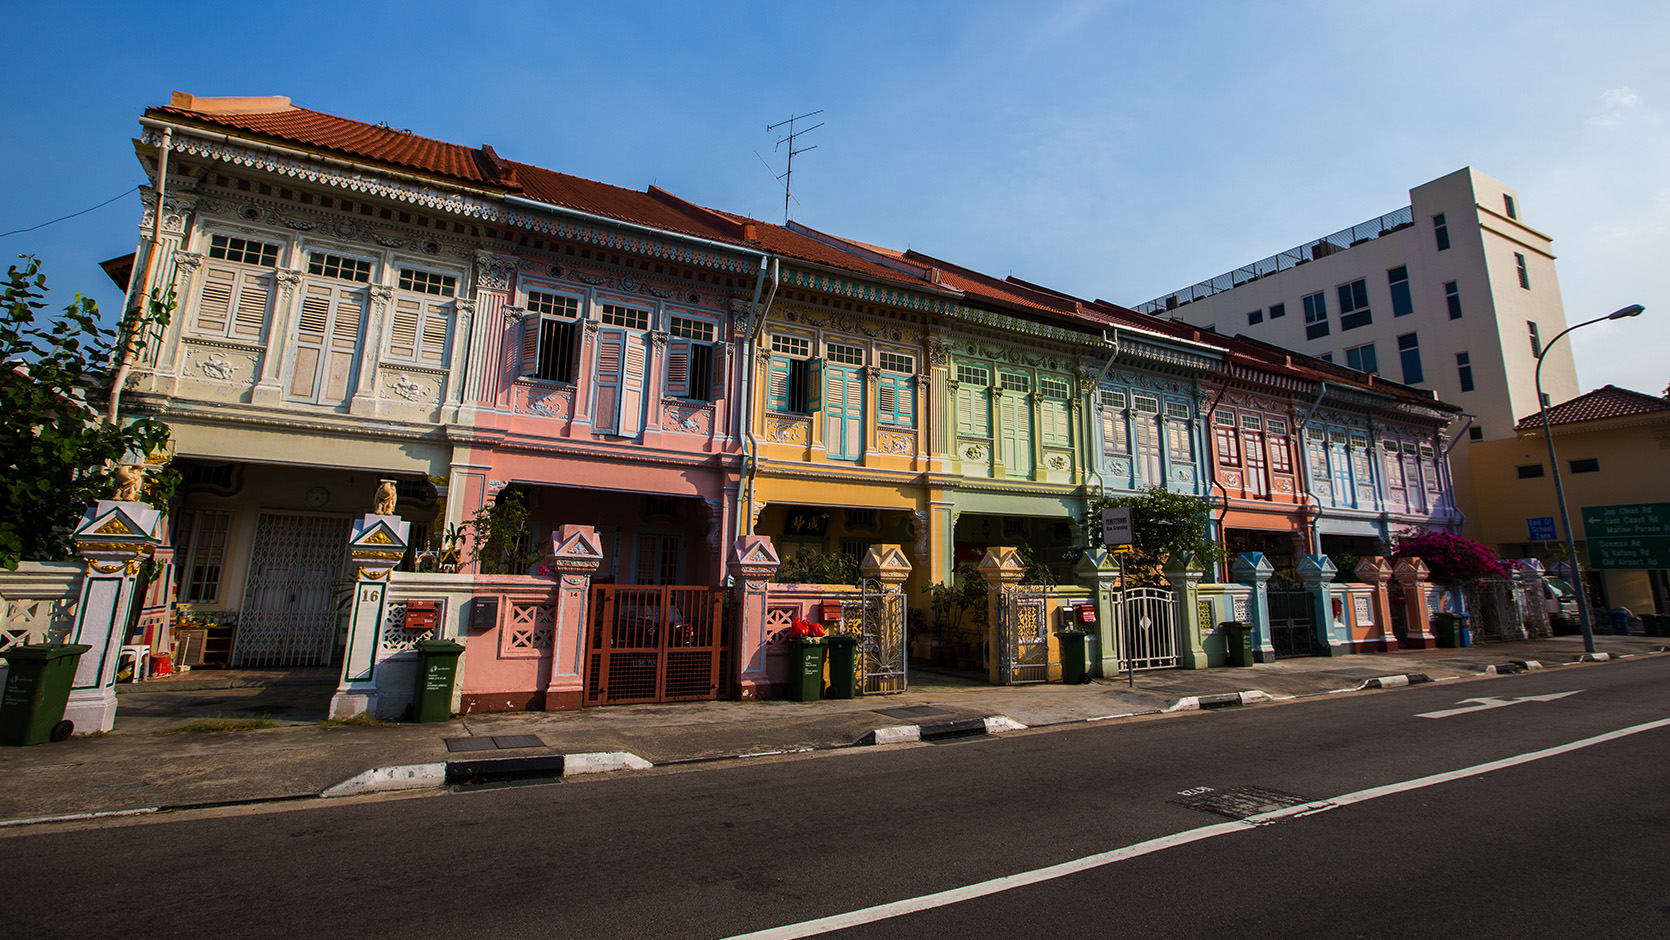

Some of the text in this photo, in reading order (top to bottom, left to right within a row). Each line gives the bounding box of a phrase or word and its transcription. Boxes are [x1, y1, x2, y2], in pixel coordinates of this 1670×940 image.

[1641, 506, 1652, 514] Rd
[1604, 515, 1659, 525] East Coast Rd
[1530, 525, 1553, 533] School
[1634, 524, 1661, 532] Parade
[1535, 532, 1551, 540] Zone
[1631, 539, 1641, 547] Rd
[1639, 548, 1650, 556] Rd
[1602, 557, 1658, 567] Old Airport Rd
[362, 589, 379, 602] 16
